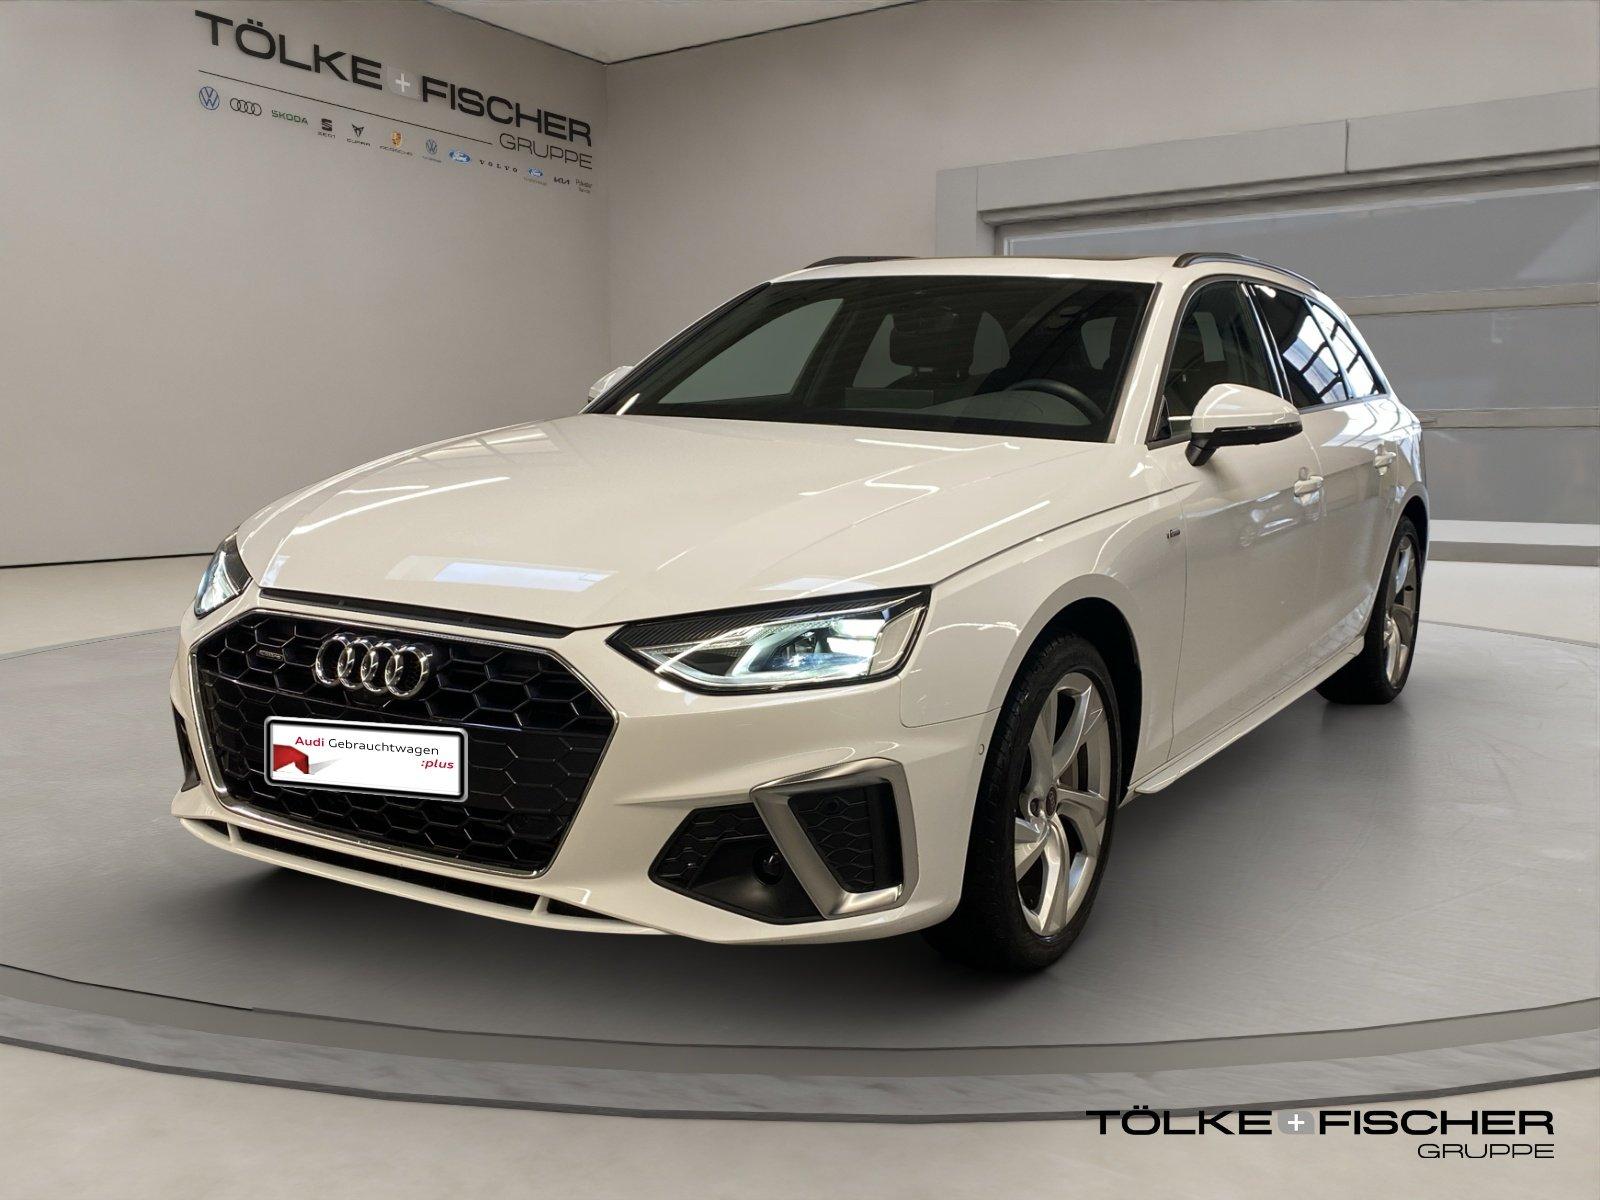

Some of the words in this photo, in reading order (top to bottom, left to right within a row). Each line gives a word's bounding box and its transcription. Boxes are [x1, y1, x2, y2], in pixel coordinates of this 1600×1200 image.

[195, 9, 383, 91] TÖLKE
[422, 75, 592, 148] FISCHER
[499, 132, 593, 170] GRUPPE
[479, 159, 518, 173] VOLVO
[295, 736, 325, 747] Audi
[328, 738, 439, 756] Gebrauchtwagen
[420, 758, 454, 770] :plus
